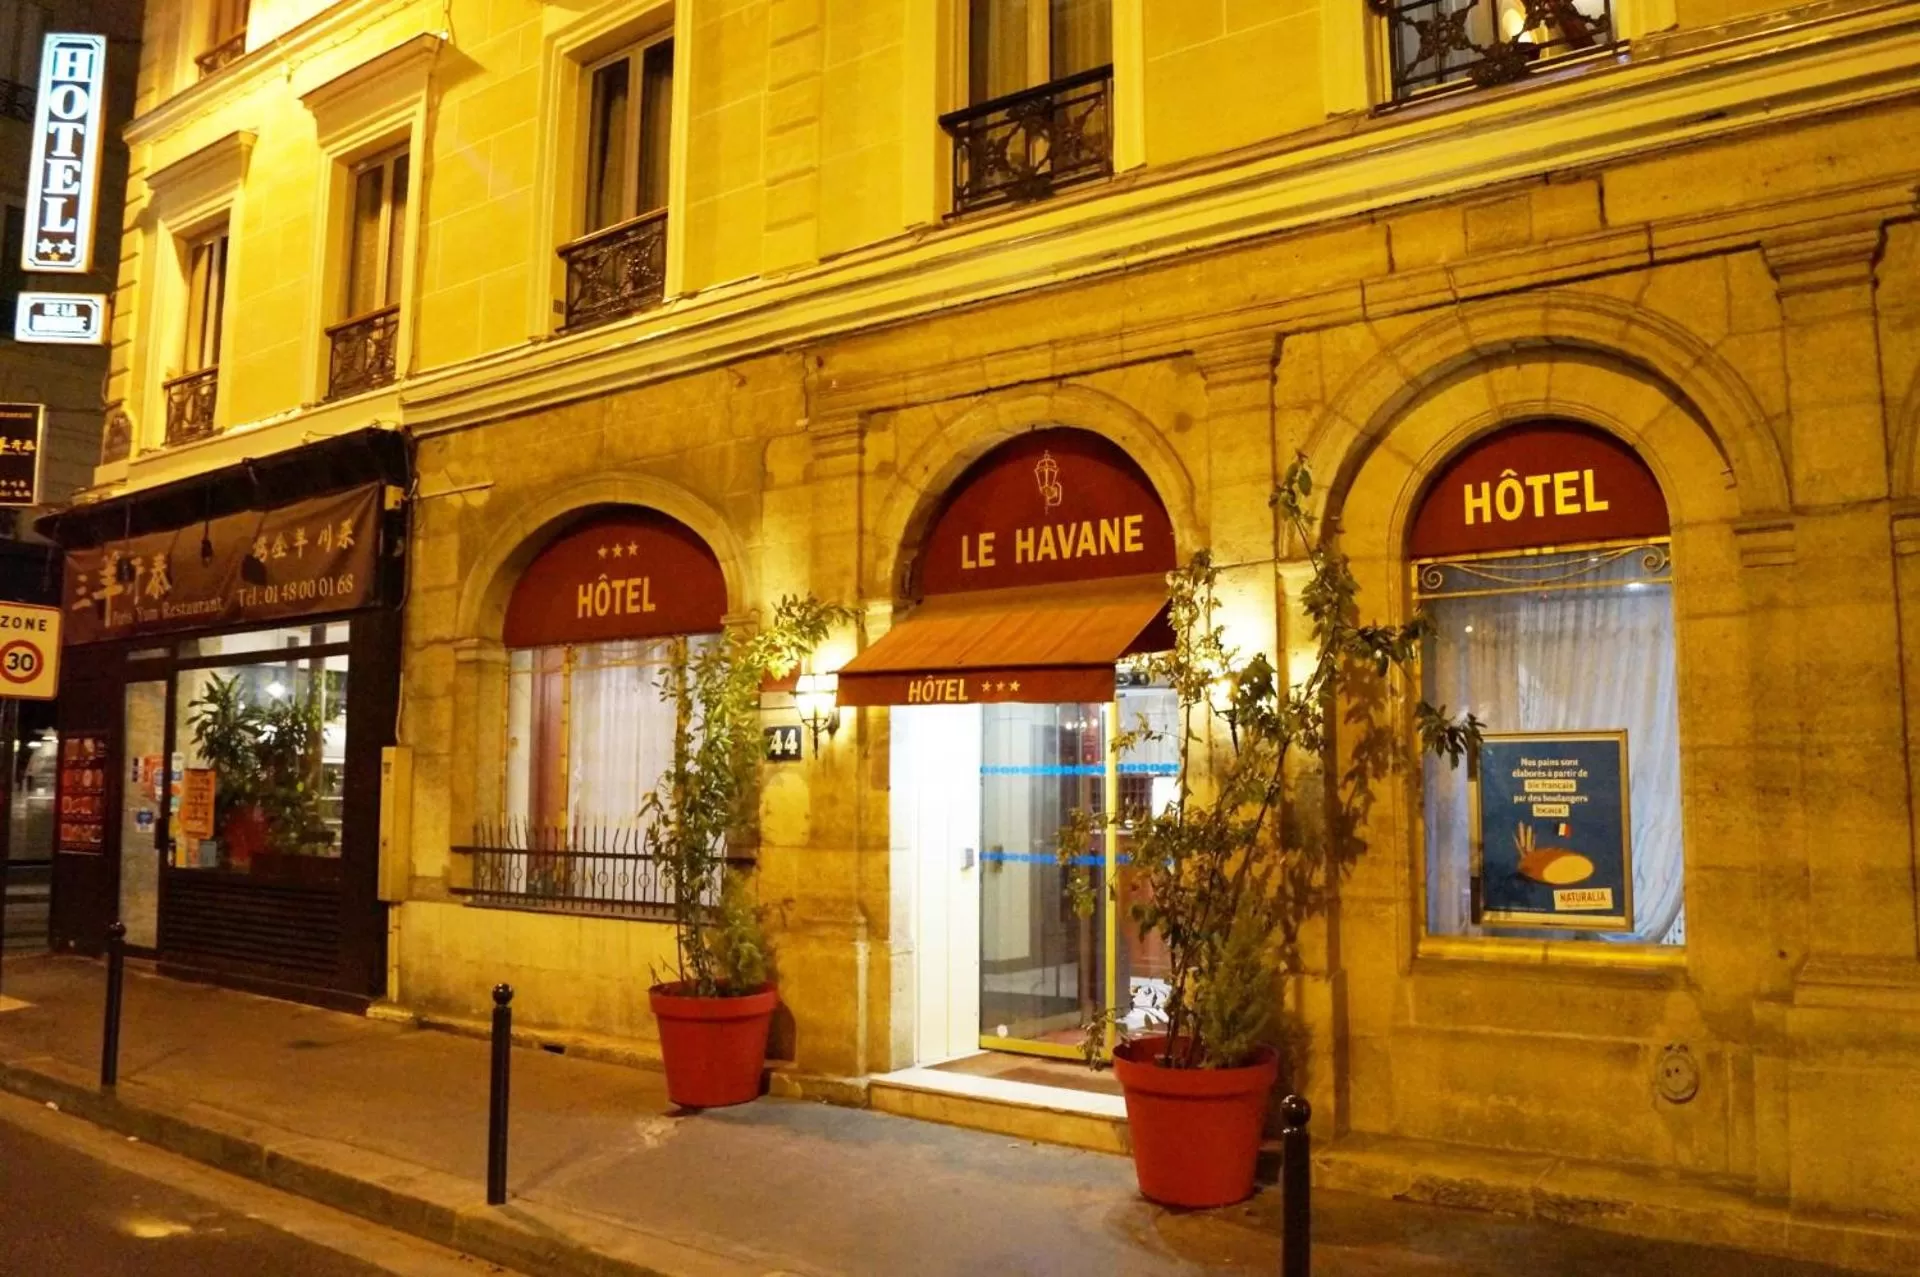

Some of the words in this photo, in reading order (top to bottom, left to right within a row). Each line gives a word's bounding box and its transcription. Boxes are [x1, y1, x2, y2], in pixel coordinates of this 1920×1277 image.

[41, 46, 92, 233] HOTEL
[1464, 468, 1609, 525] HÔTEL
[962, 532, 995, 569] LE
[1015, 514, 1144, 563] HAVANE
[318, 577, 334, 597] 01
[577, 573, 656, 618] HÔTEL
[0, 615, 48, 632] ZONE
[6, 651, 35, 672] 30
[907, 674, 969, 703] HÔTEL
[769, 728, 798, 755] 44
[1553, 768, 1577, 779] partir
[1577, 767, 1588, 777] de
[1560, 758, 1579, 767] sont
[1527, 793, 1541, 803] des
[1559, 890, 1607, 902] NATURALIA
